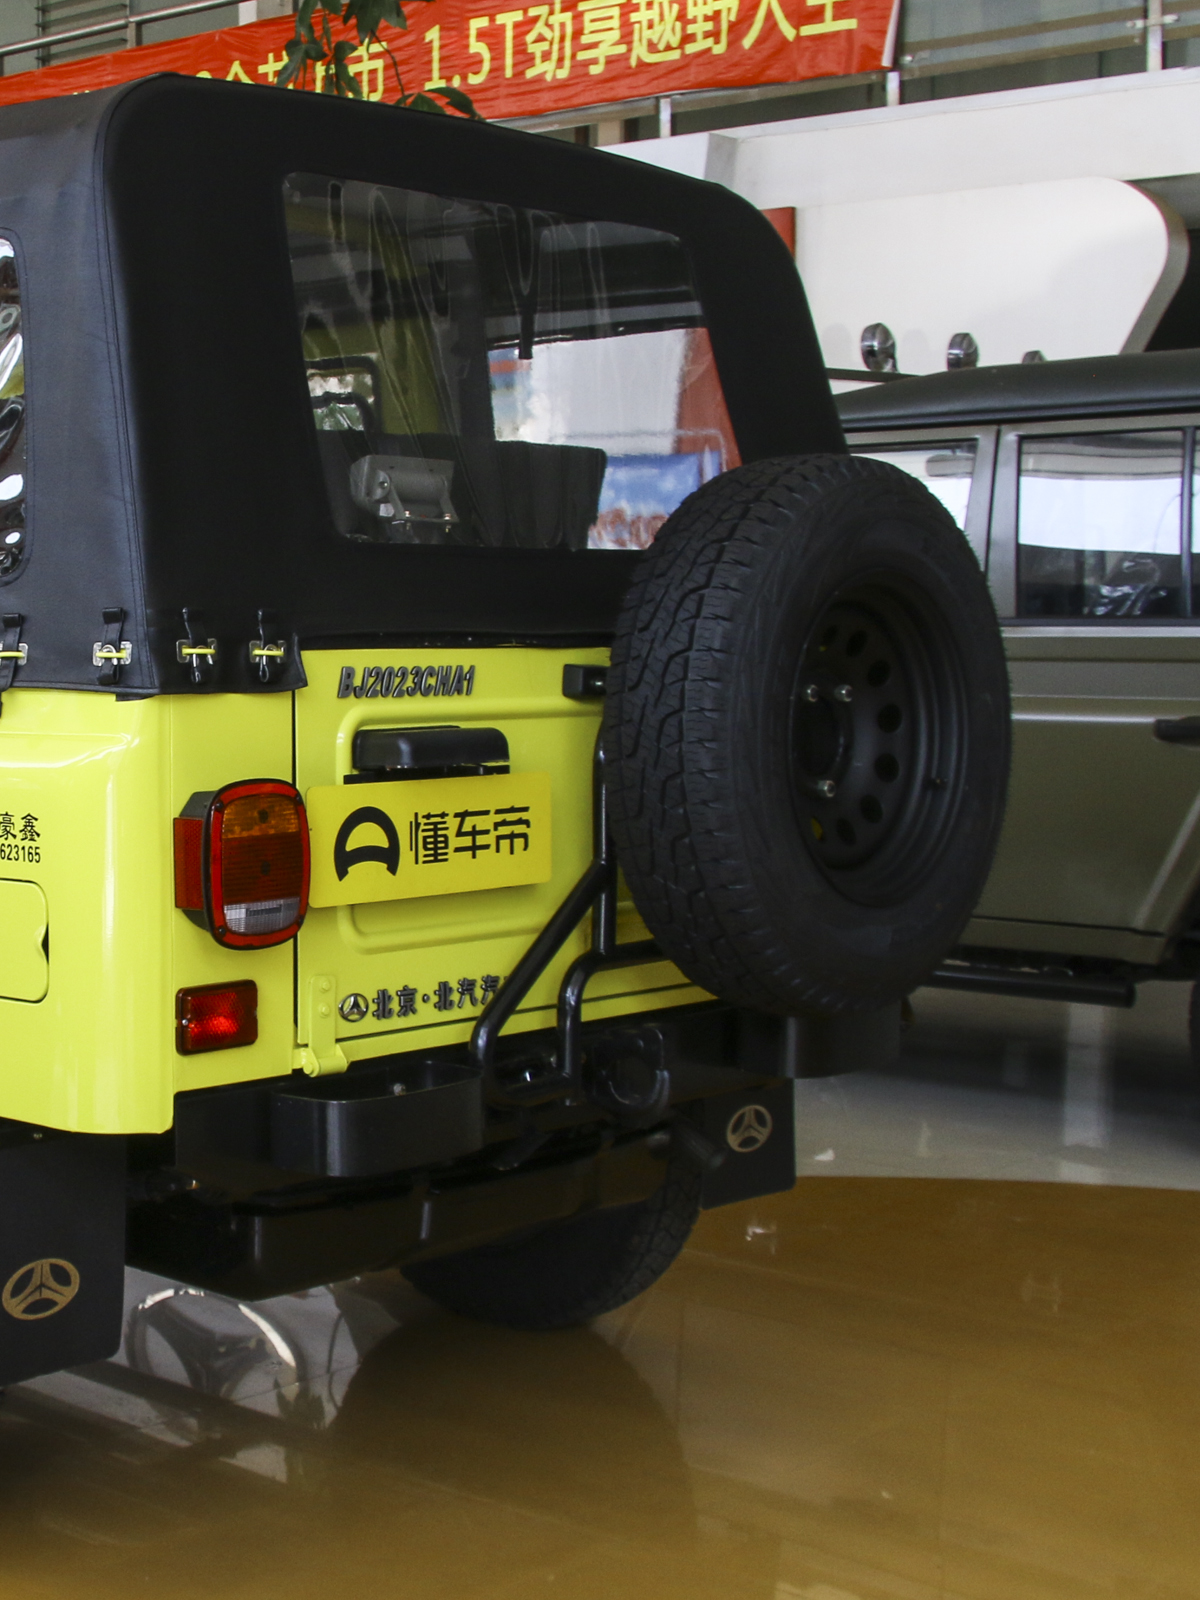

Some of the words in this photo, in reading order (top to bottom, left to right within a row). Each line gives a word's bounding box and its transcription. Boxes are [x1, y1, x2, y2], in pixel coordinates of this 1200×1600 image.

[337, 664, 476, 699] BJ2023CHA1
[409, 805, 531, 865] 懂车帝
[372, 974, 509, 1021] 北京·北汽汽
